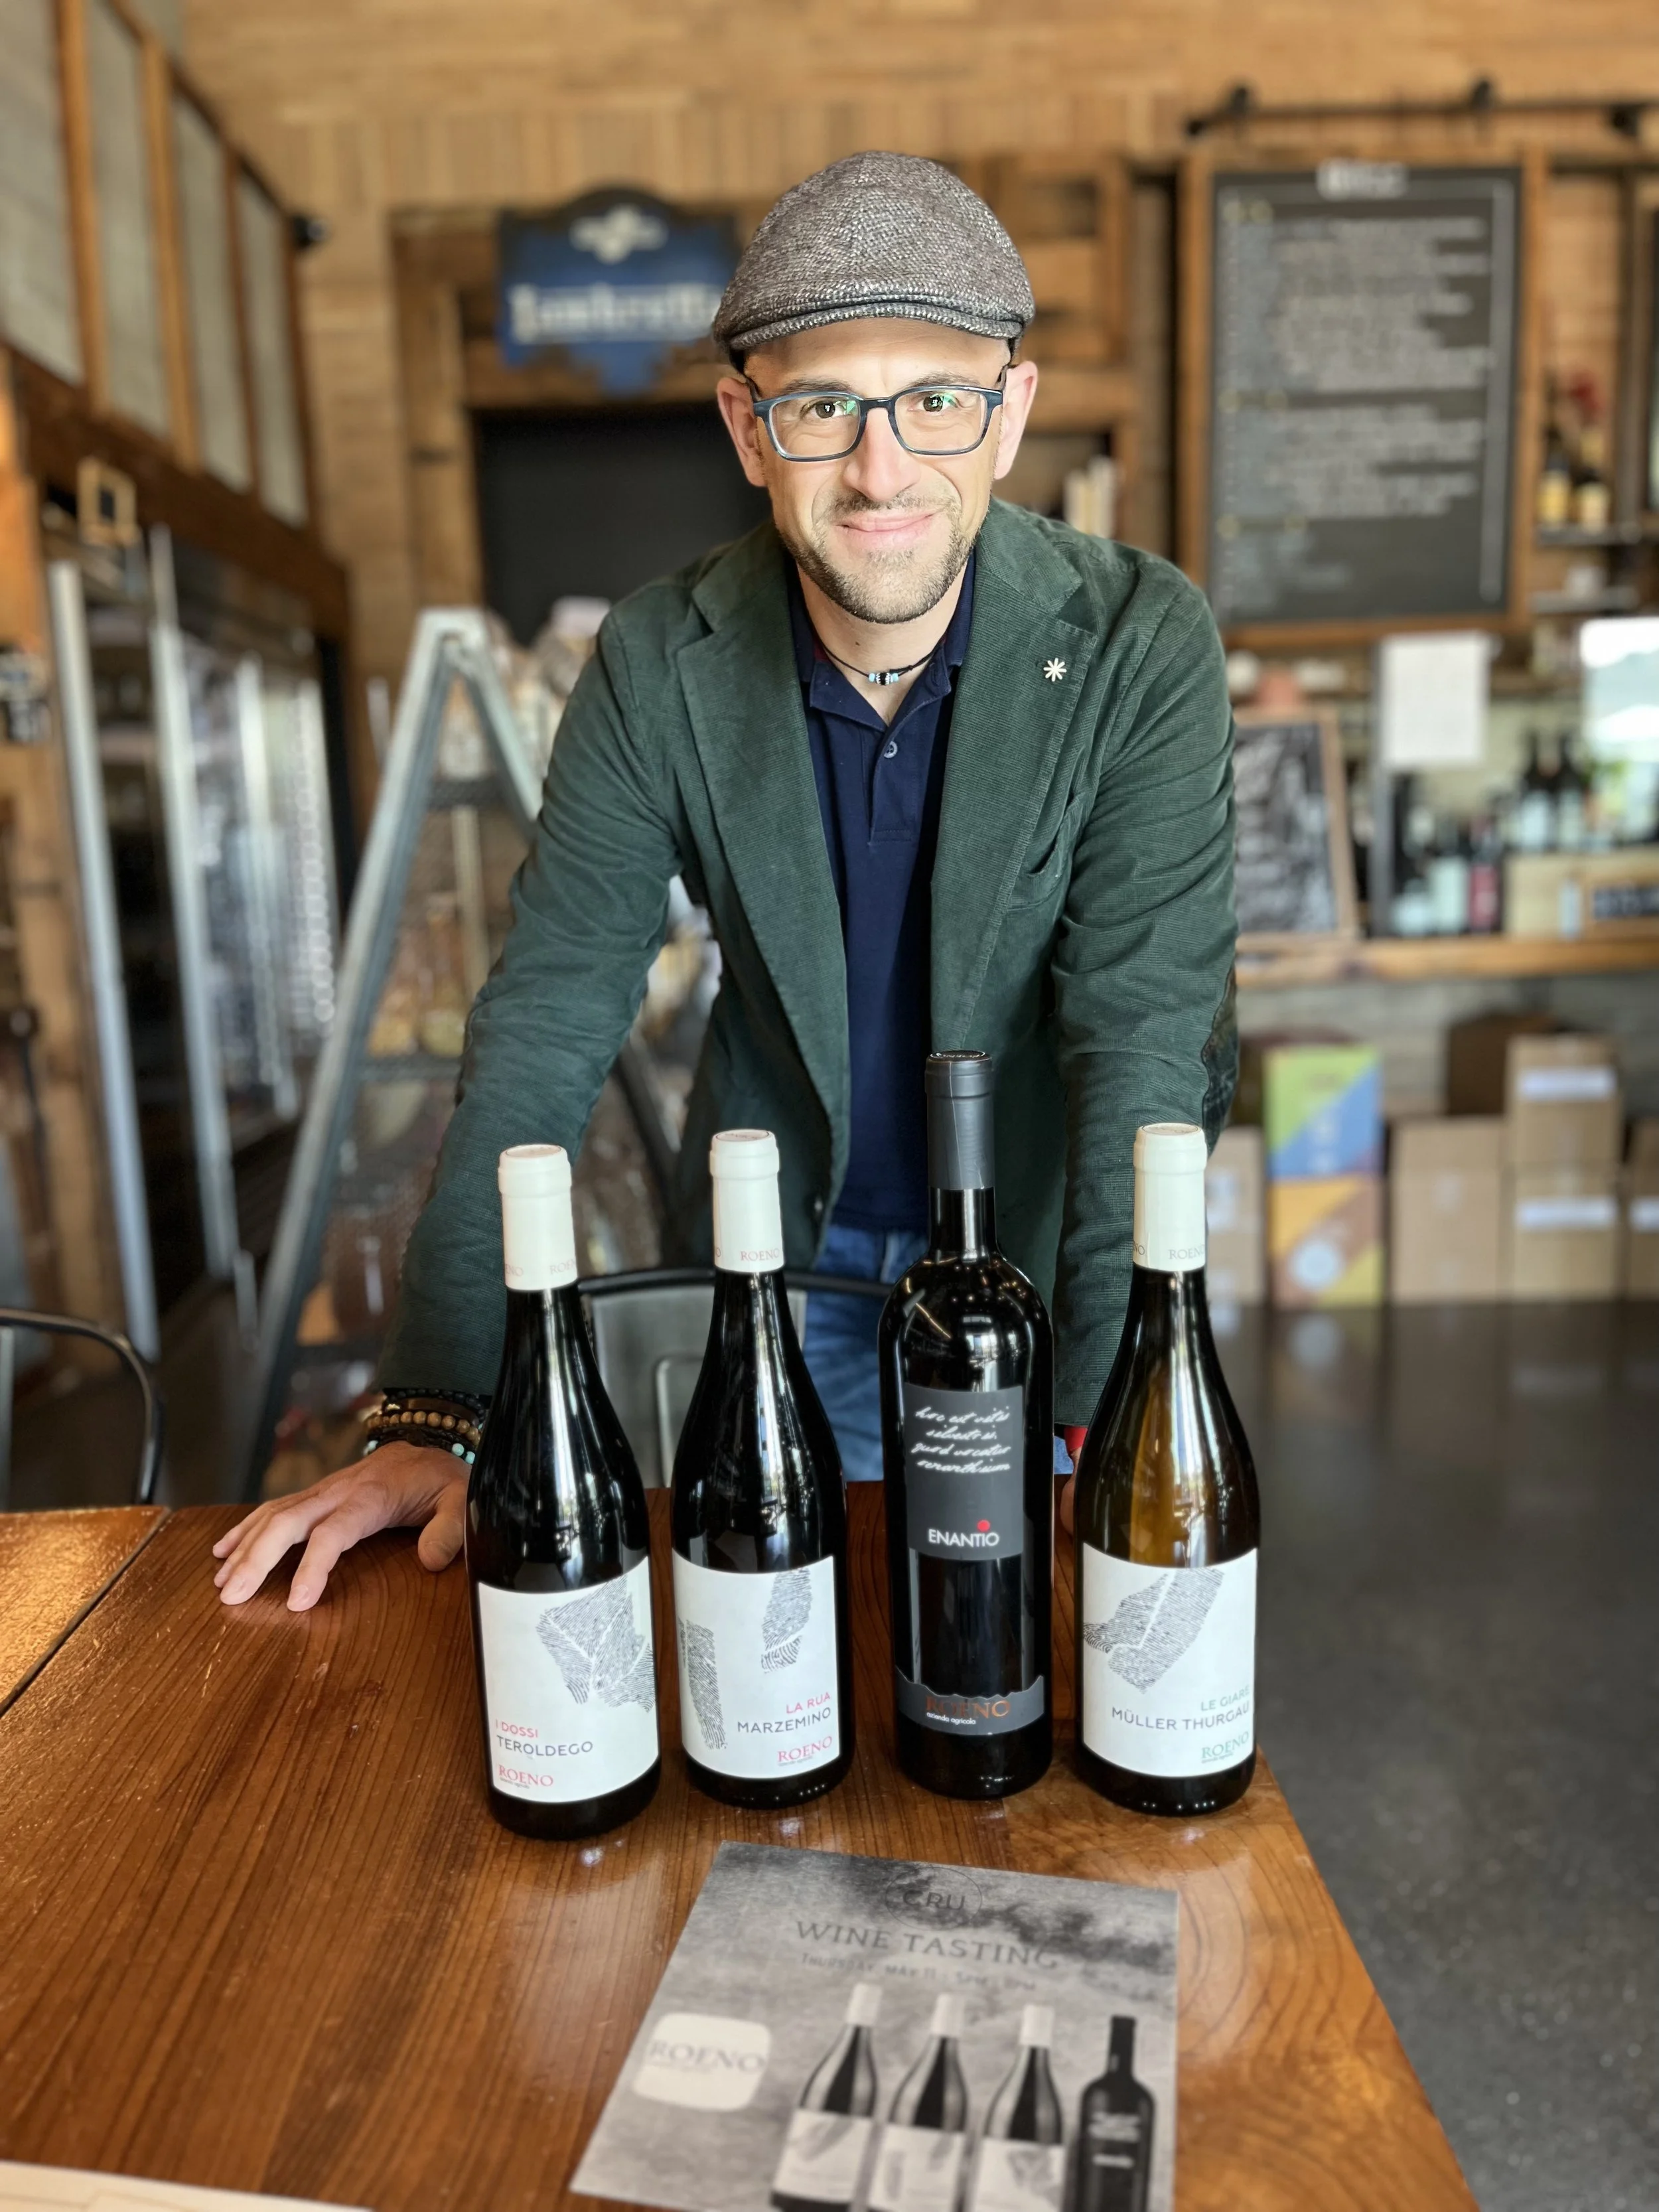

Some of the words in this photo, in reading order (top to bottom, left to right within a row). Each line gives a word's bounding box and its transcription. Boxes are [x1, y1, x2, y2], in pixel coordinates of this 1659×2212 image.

[740, 1248, 780, 1262] ROENO
[928, 1528, 1000, 1547] ENANTIO
[786, 1702, 803, 1714] LA
[807, 1692, 831, 1709] RUA
[925, 1695, 1011, 1720] ROENO
[1201, 1699, 1216, 1712] LE
[1220, 1684, 1250, 1707] GIARE
[737, 1707, 831, 1733] MARZEMINO
[926, 1712, 950, 1722] azienda
[1112, 1706, 1177, 1730] MÜLLER
[1182, 1700, 1249, 1730] THURGAU
[501, 1721, 538, 1738] DOSSI
[496, 1735, 593, 1757] TEROLDEGO
[777, 1735, 833, 1762] ROENO
[1201, 1731, 1249, 1759] ROENO
[498, 1764, 553, 1787] ROENO
[902, 1889, 966, 1911] CRU
[796, 1921, 891, 1949] WINE
[903, 1933, 1058, 1970] TASTING
